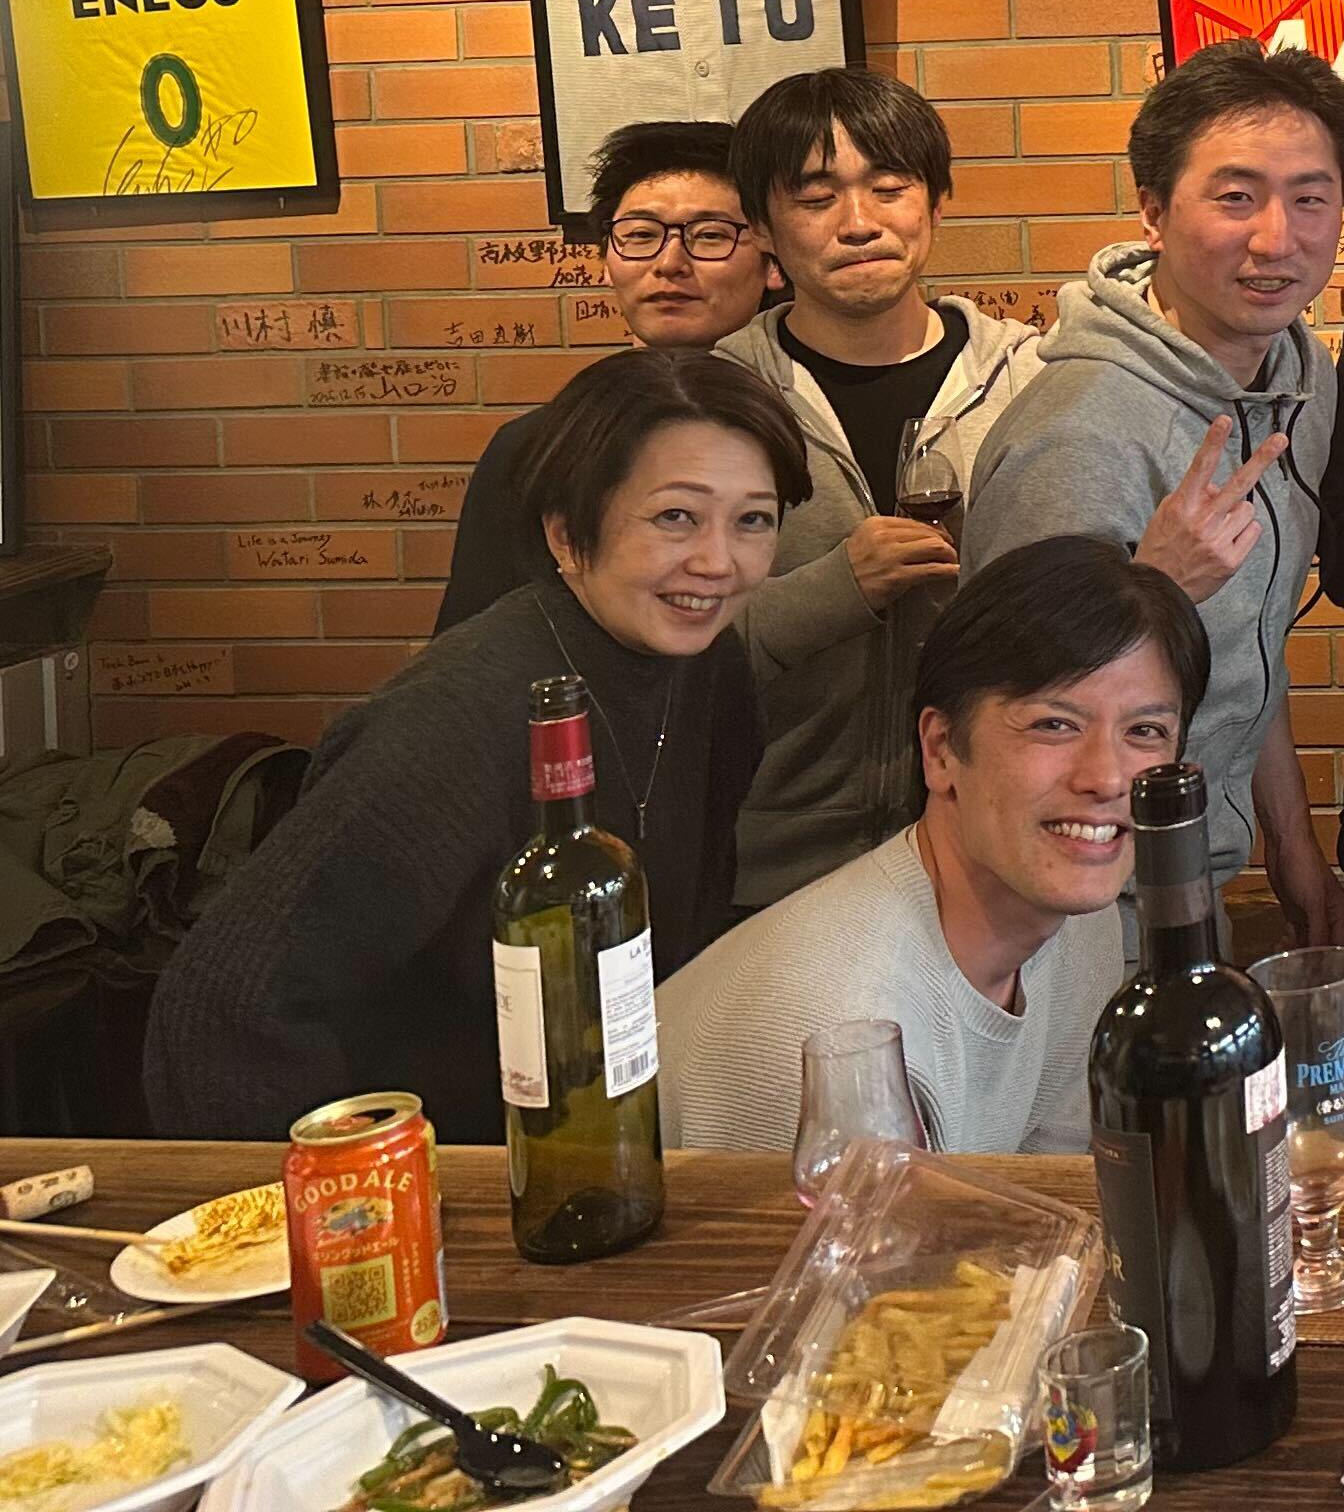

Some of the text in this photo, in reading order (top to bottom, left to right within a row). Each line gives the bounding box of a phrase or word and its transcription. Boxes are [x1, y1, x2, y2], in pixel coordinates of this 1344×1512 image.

[140, 52, 202, 148] 0
[238, 534, 263, 548] Life
[319, 550, 369, 566] Sumida
[294, 1169, 414, 1212] GOOD ALE
